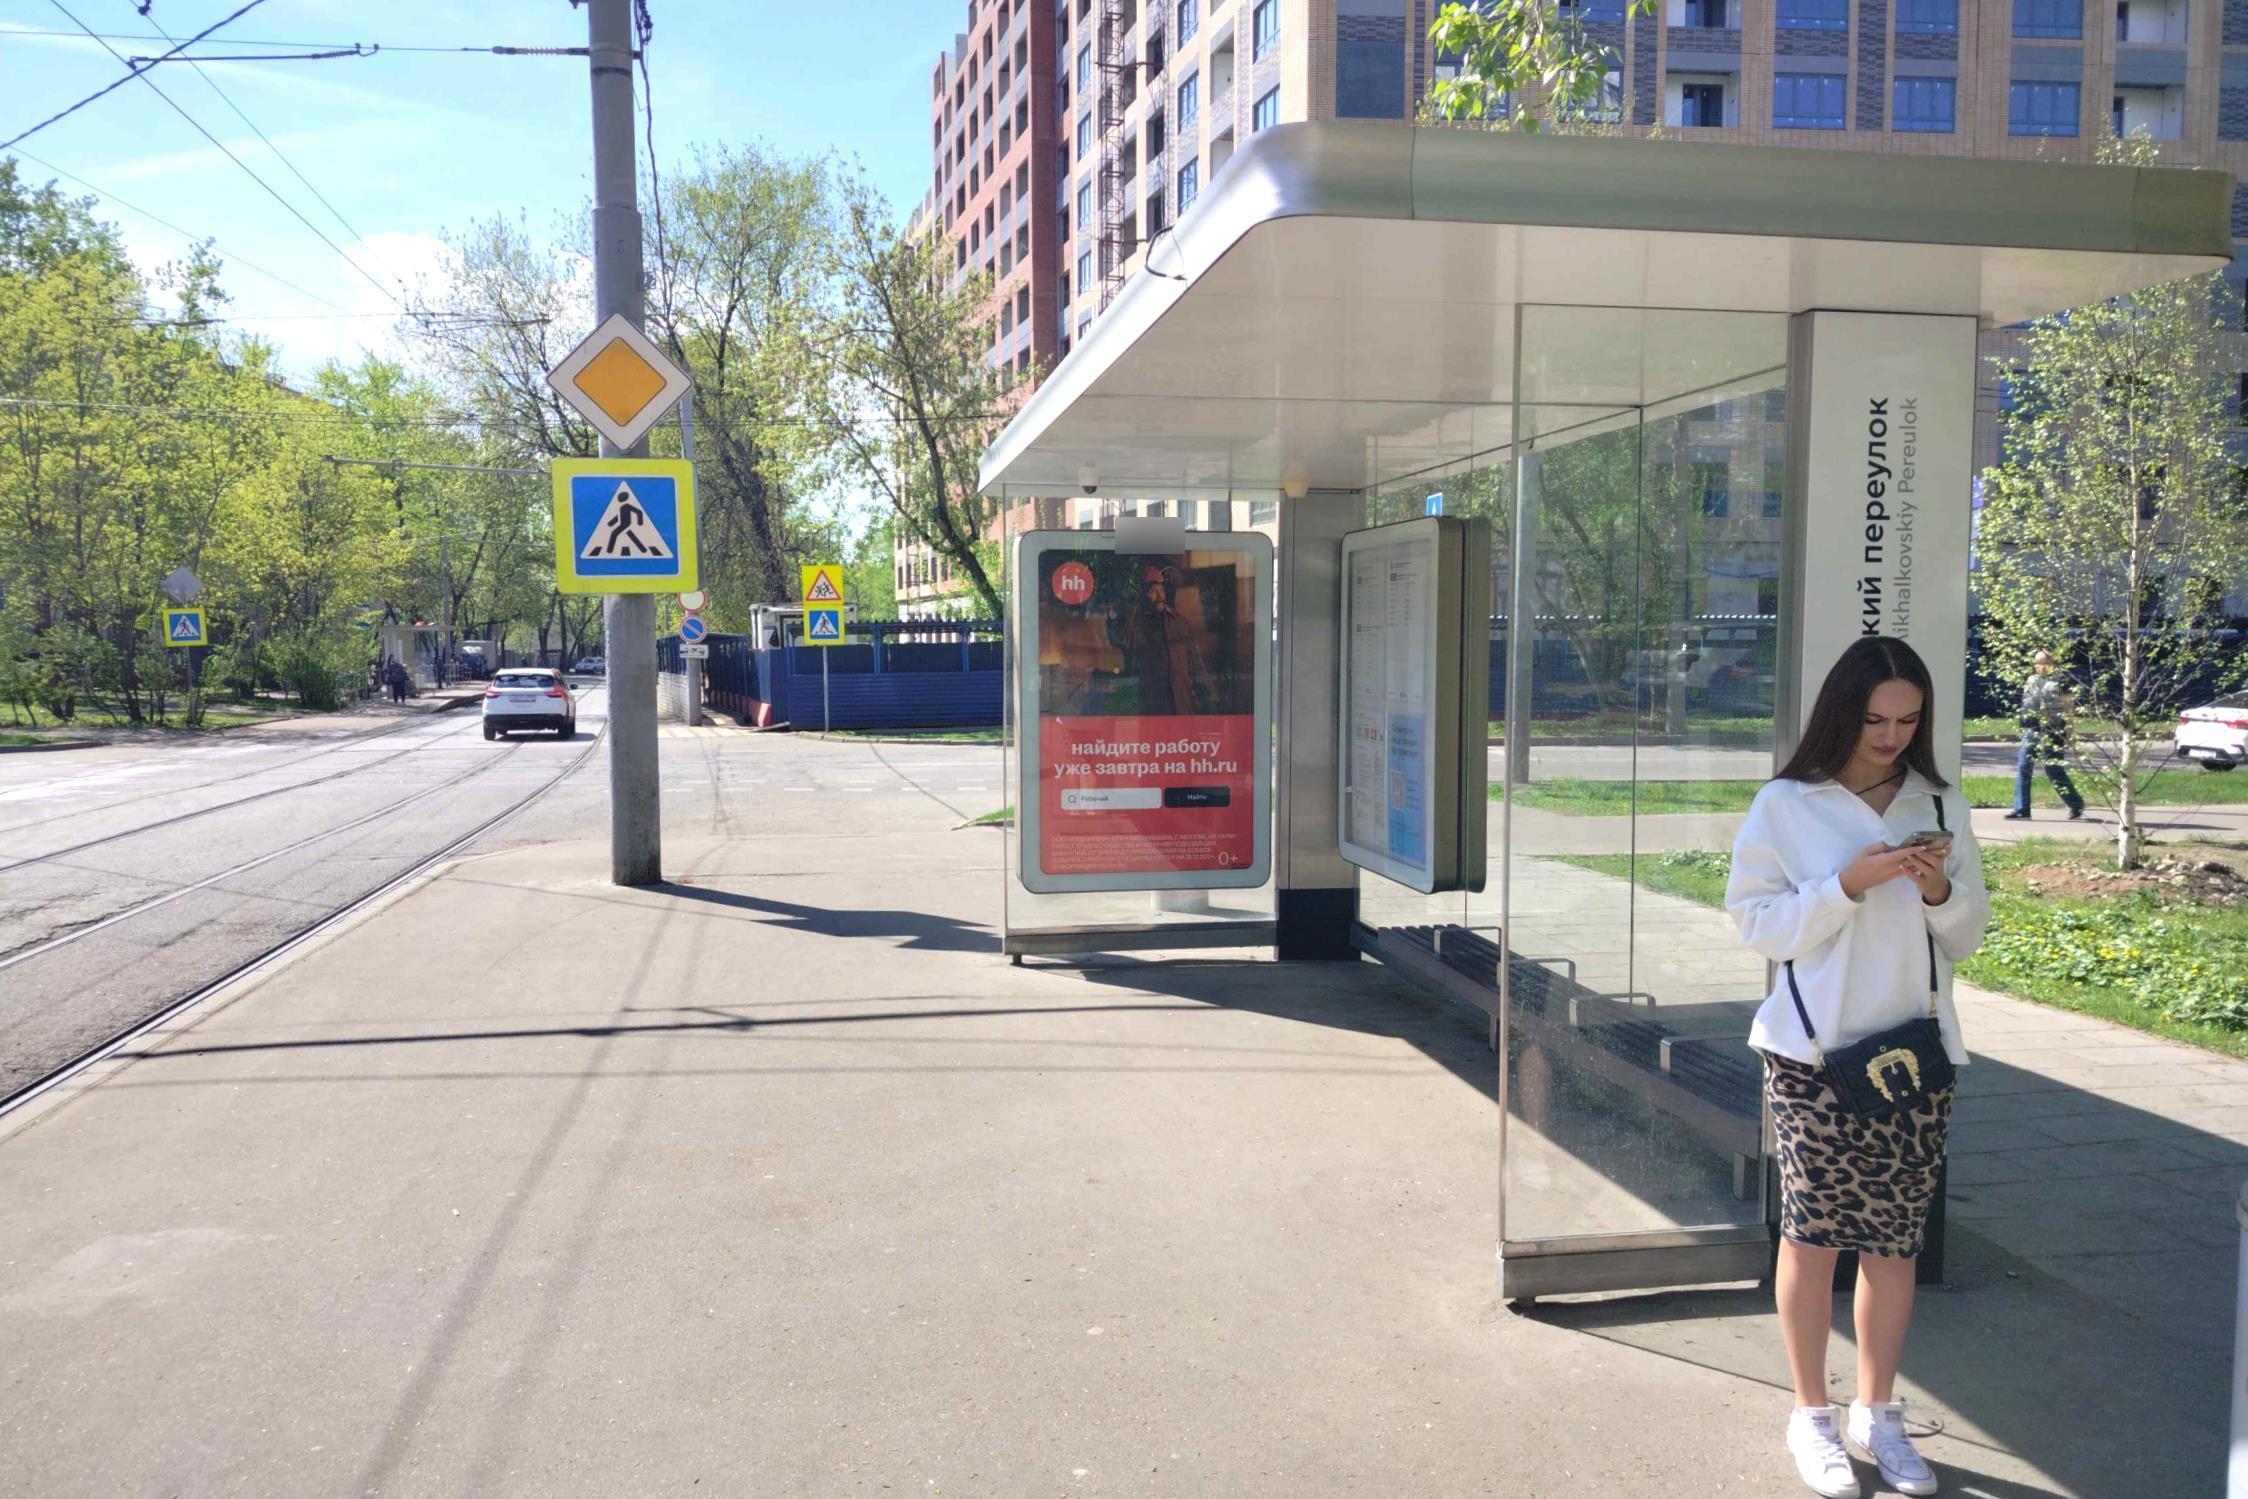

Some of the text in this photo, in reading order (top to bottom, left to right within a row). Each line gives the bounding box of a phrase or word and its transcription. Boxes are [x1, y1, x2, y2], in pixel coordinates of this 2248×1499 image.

[1864, 397, 1892, 563] переулок
[1892, 397, 1918, 639] ikhalkovskiy Pereulok
[1061, 575, 1085, 590] hh
[1071, 738, 1221, 757] найдите работу
[1054, 758, 1238, 779] уже завтра на hh.ru
[1218, 851, 1239, 865] 0+
